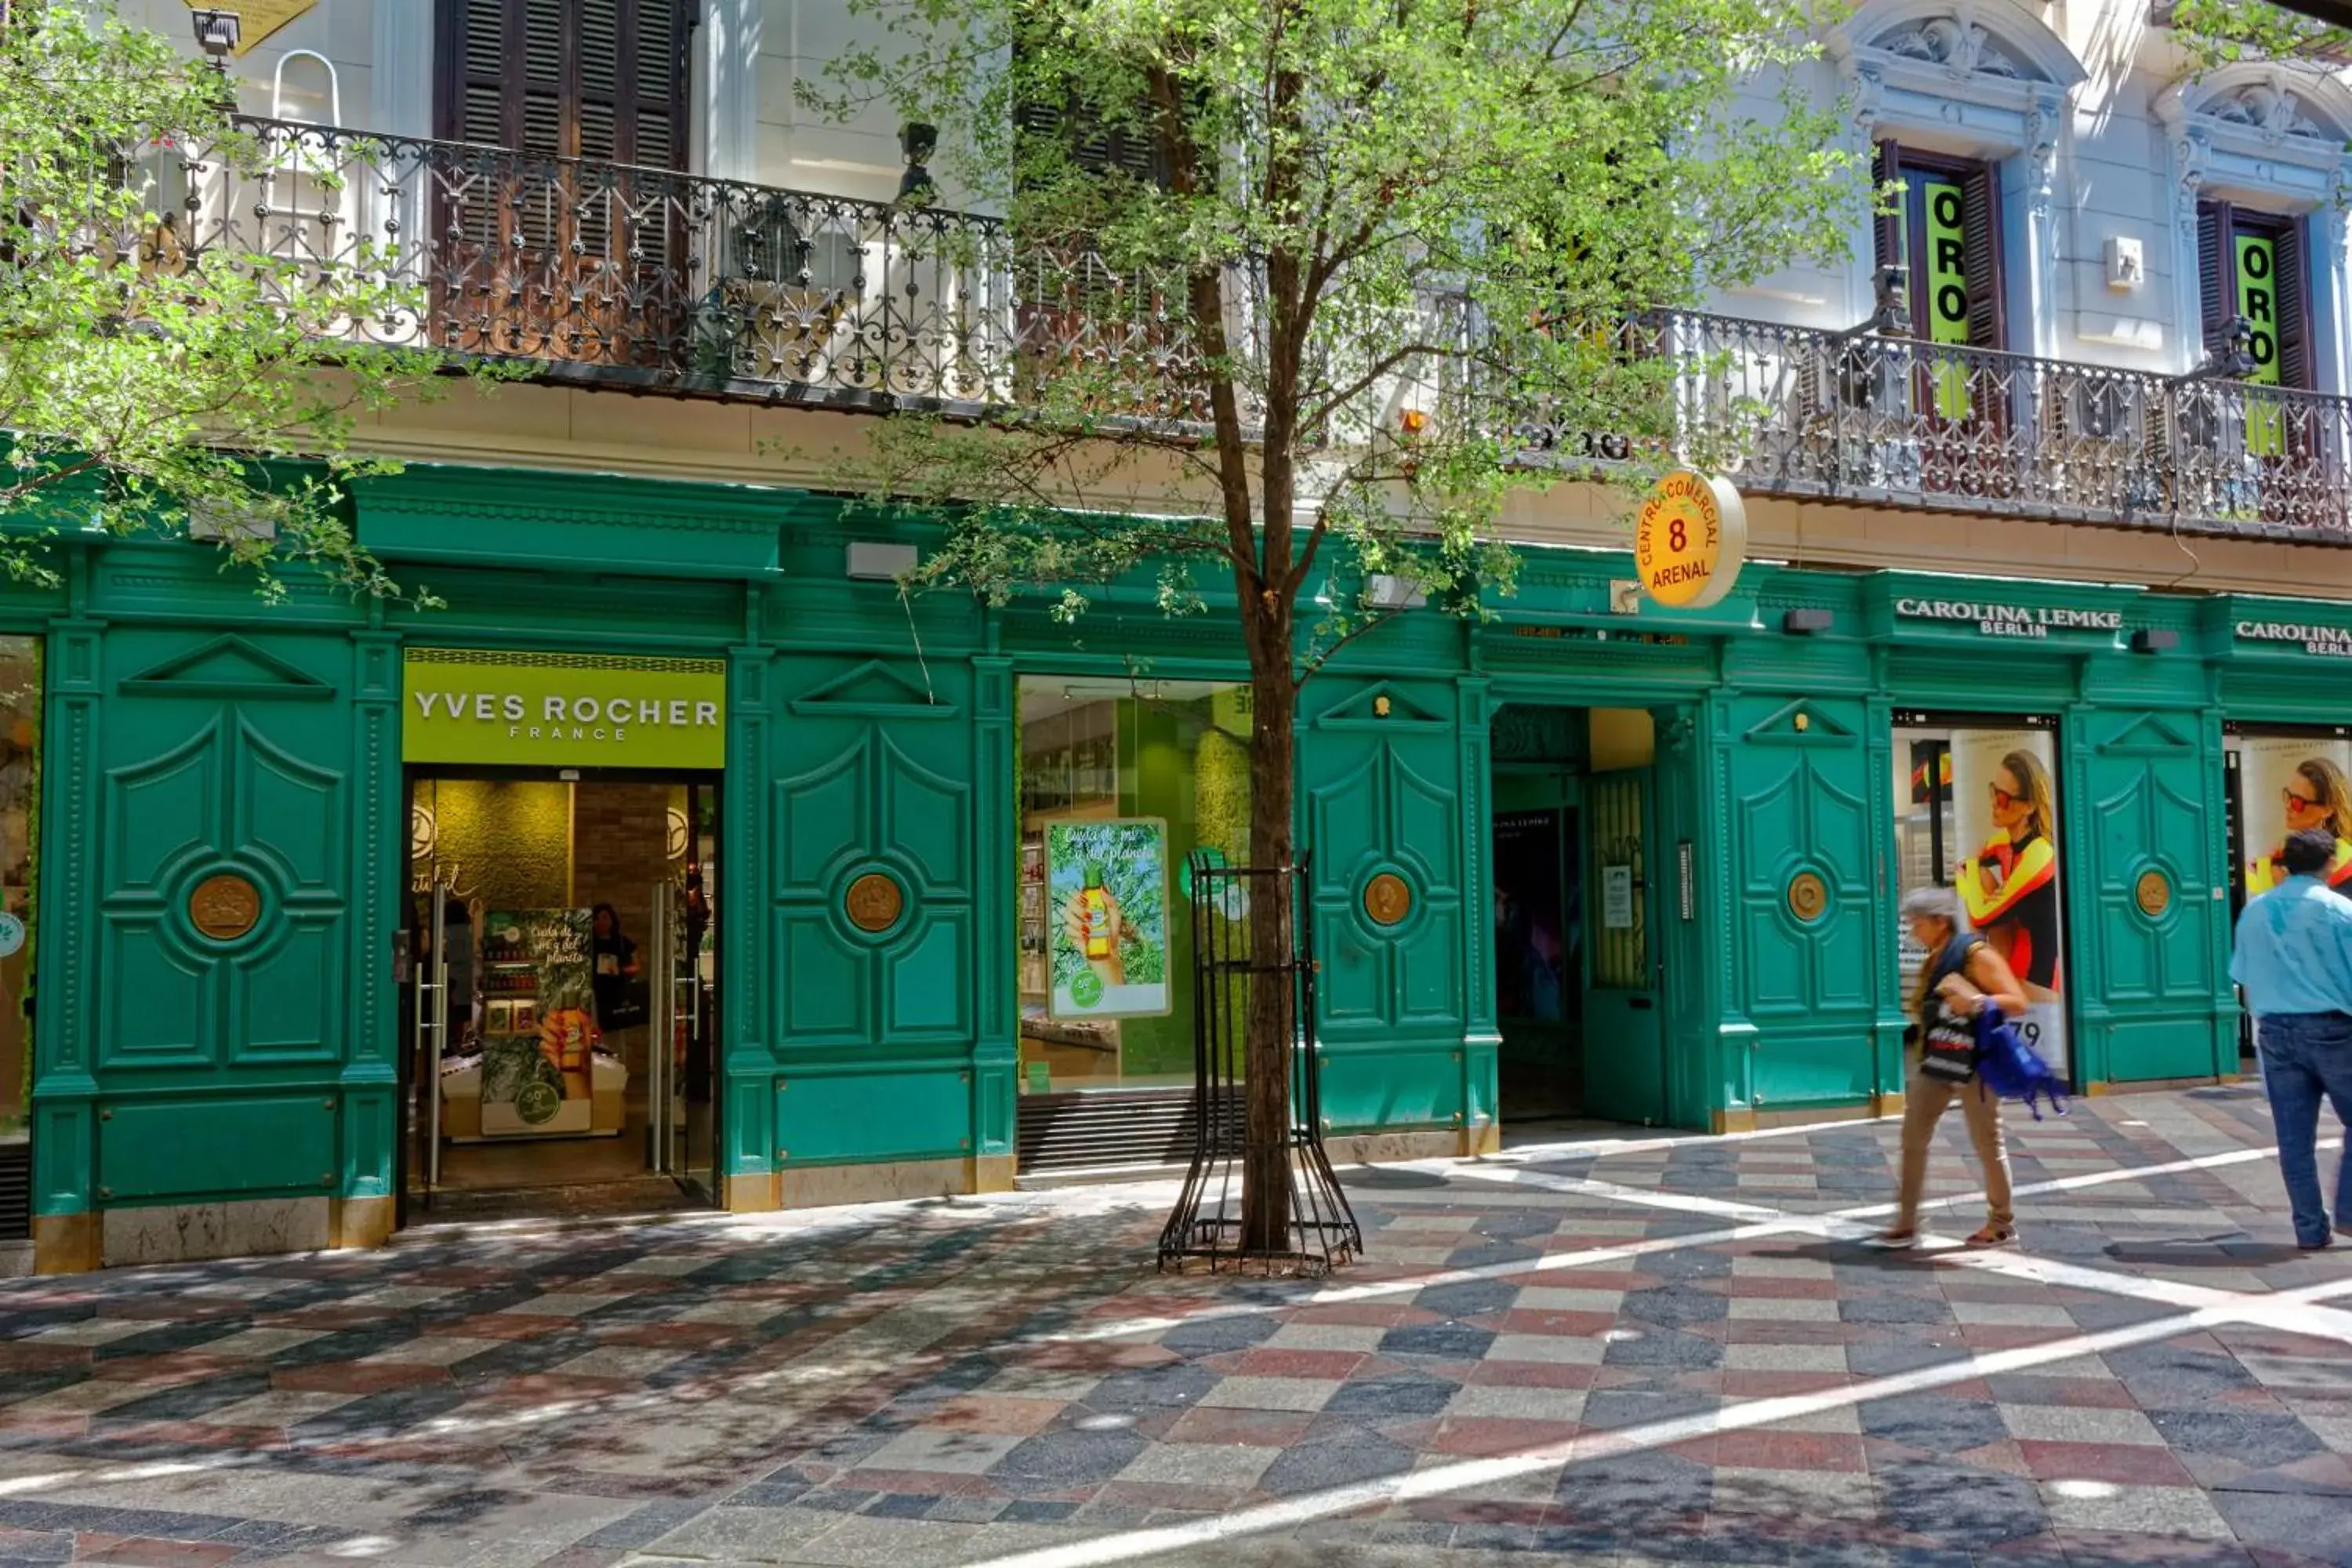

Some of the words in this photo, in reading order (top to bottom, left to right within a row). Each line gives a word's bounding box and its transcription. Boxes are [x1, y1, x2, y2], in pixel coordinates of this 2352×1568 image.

[1933, 191, 1967, 322] ORO
[2243, 245, 2274, 365] ORO
[1666, 479, 1718, 548] COMERCIAL
[1669, 518, 1686, 553] 8
[1652, 559, 1710, 590] ARENAL
[1896, 598, 2031, 623] CAROLINA
[2038, 608, 2122, 628] LEMKE
[1980, 620, 2047, 638] BERLIN
[2235, 621, 2352, 643] CAROLINA
[415, 691, 524, 720] YVES
[544, 695, 717, 725] ROCHER
[510, 726, 626, 741] FRANCE
